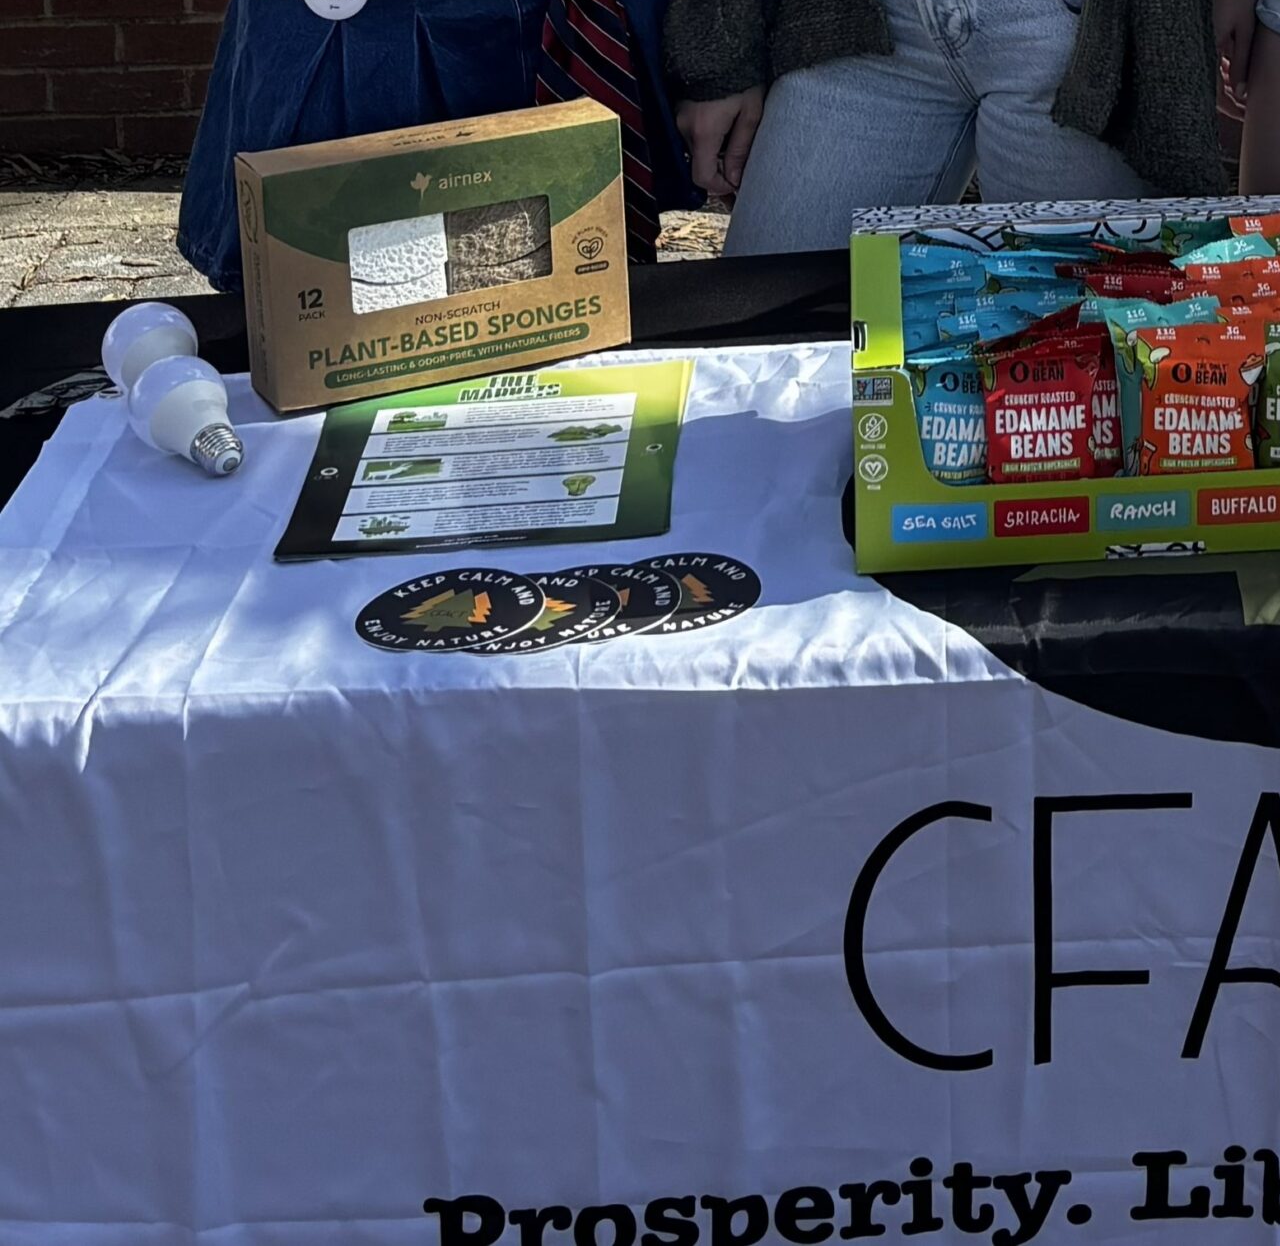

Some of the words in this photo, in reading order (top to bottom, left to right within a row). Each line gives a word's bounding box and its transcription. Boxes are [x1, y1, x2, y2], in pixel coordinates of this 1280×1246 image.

[438, 170, 492, 191] airnex
[1104, 276, 1123, 285] 11G
[297, 288, 324, 310] 12
[299, 311, 326, 322] PACK
[415, 300, 501, 326] NON-SCRATCH
[959, 314, 976, 324] 11G
[1126, 309, 1145, 318] 11G
[309, 320, 479, 370] PLANT-BASED
[487, 295, 602, 336] SPONGES
[337, 363, 407, 383] LONG-LASTING
[477, 343, 503, 356] WITH
[504, 335, 547, 351] NATURAL
[549, 327, 581, 340] FIBERS
[1033, 366, 1065, 382] BEAN
[1195, 370, 1227, 386] BEAN
[934, 402, 967, 414] CRUNCHY
[1005, 393, 1039, 405] CRUNCHY
[1041, 391, 1076, 403] ROASTED
[1164, 393, 1199, 406] CRUNCHY
[1201, 396, 1236, 408] ROASTED
[921, 416, 986, 442] EDAMA
[995, 405, 1087, 434] EDAMAME
[1154, 407, 1244, 432] EDAMAME
[1010, 432, 1073, 459] BEANS
[1168, 433, 1231, 455] BEANS
[1110, 499, 1176, 521] RANCH
[1211, 495, 1277, 516] BUFFALO
[902, 516, 937, 531] SEA
[941, 514, 977, 530] SALT
[1004, 508, 1080, 528] SRIRACHA
[651, 557, 708, 569] CALM
[713, 562, 746, 581] AND
[393, 575, 446, 598] KEEP
[458, 571, 513, 586] CALM
[511, 585, 535, 606] AND
[536, 576, 579, 588] AND
[610, 567, 657, 585] CALM
[654, 584, 670, 607] AND
[662, 601, 745, 632] NATURE
[364, 618, 408, 644] ENJOY
[416, 625, 509, 647] NATURE
[474, 636, 546, 651] NJOY
[423, 1157, 1093, 1246] Prosperity.
